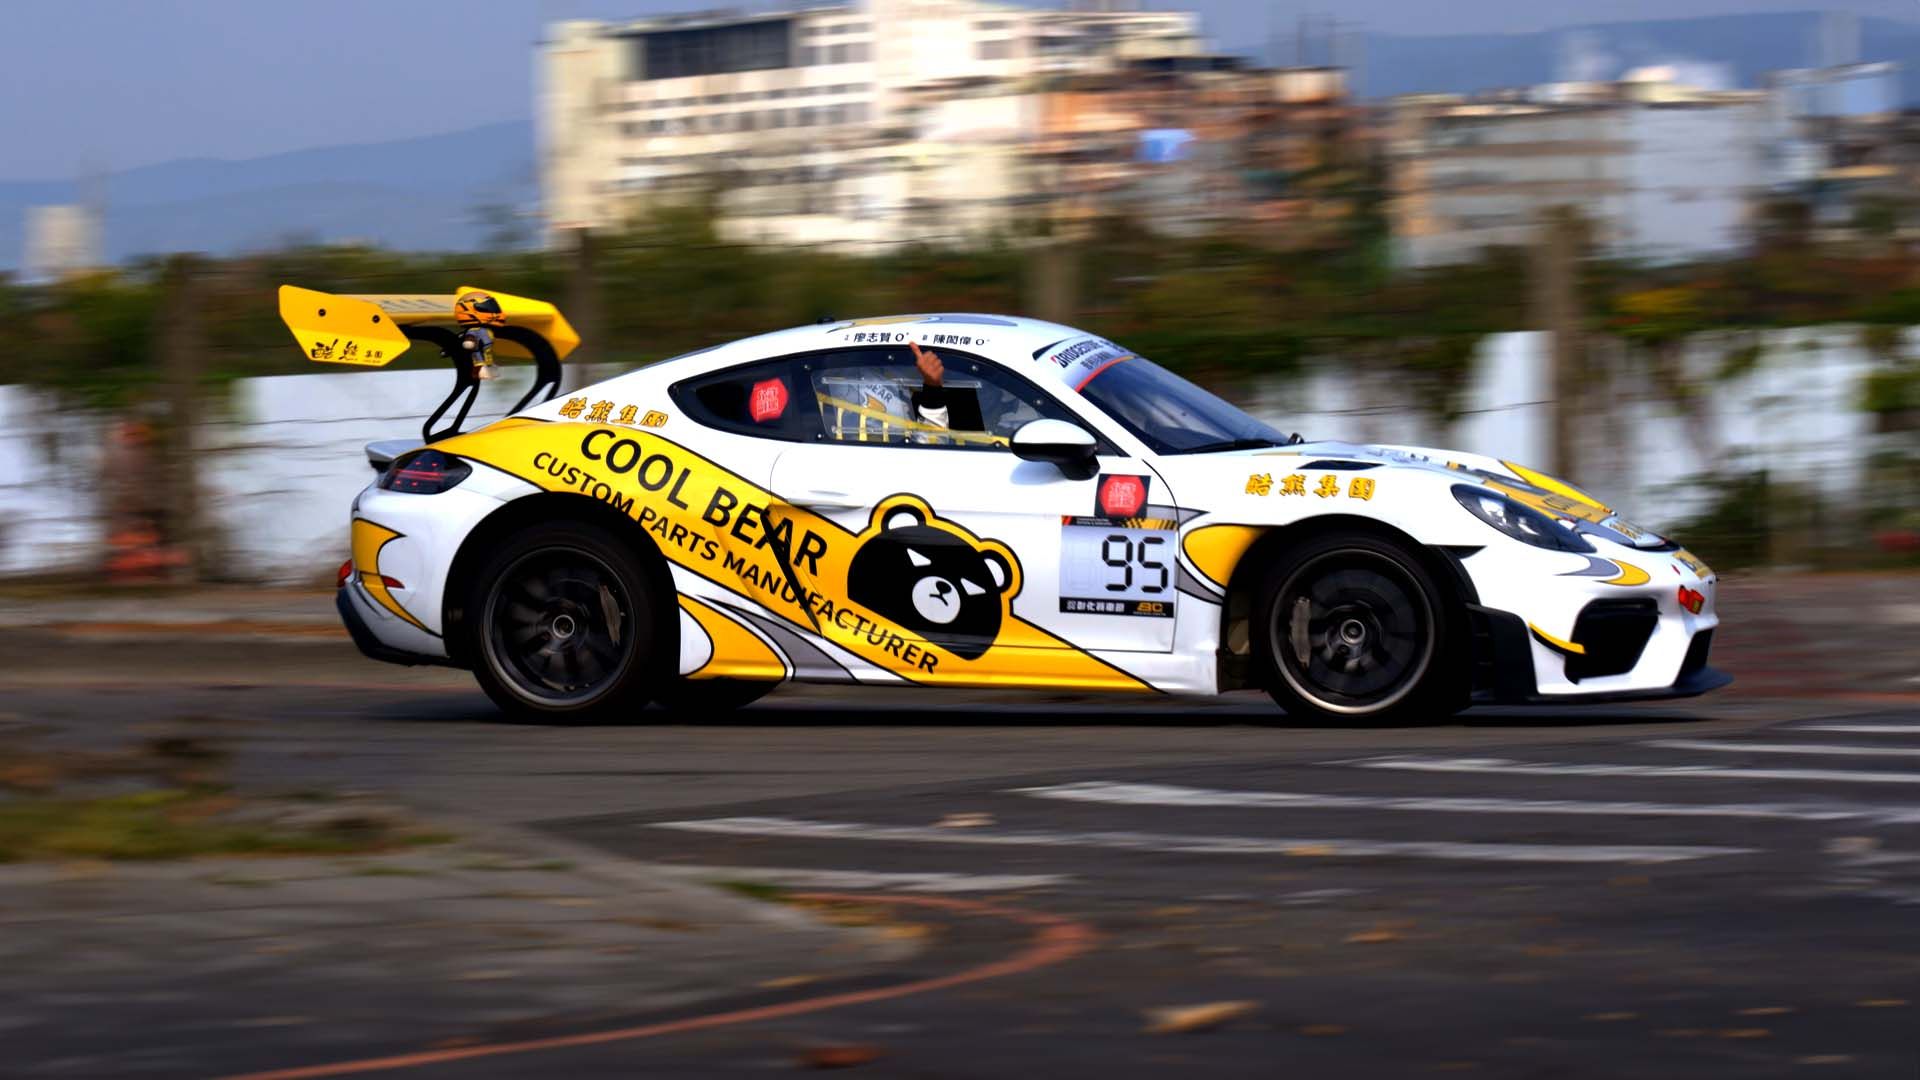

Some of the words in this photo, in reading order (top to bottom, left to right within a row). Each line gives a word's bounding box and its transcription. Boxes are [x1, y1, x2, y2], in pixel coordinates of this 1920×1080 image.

[533, 452, 634, 514] CUSTOM
[635, 505, 720, 561] PARTS
[722, 551, 939, 674] MANUFACTURER
[581, 429, 691, 511] COOL
[702, 486, 828, 577] BEAR
[1101, 534, 1169, 594] 95
